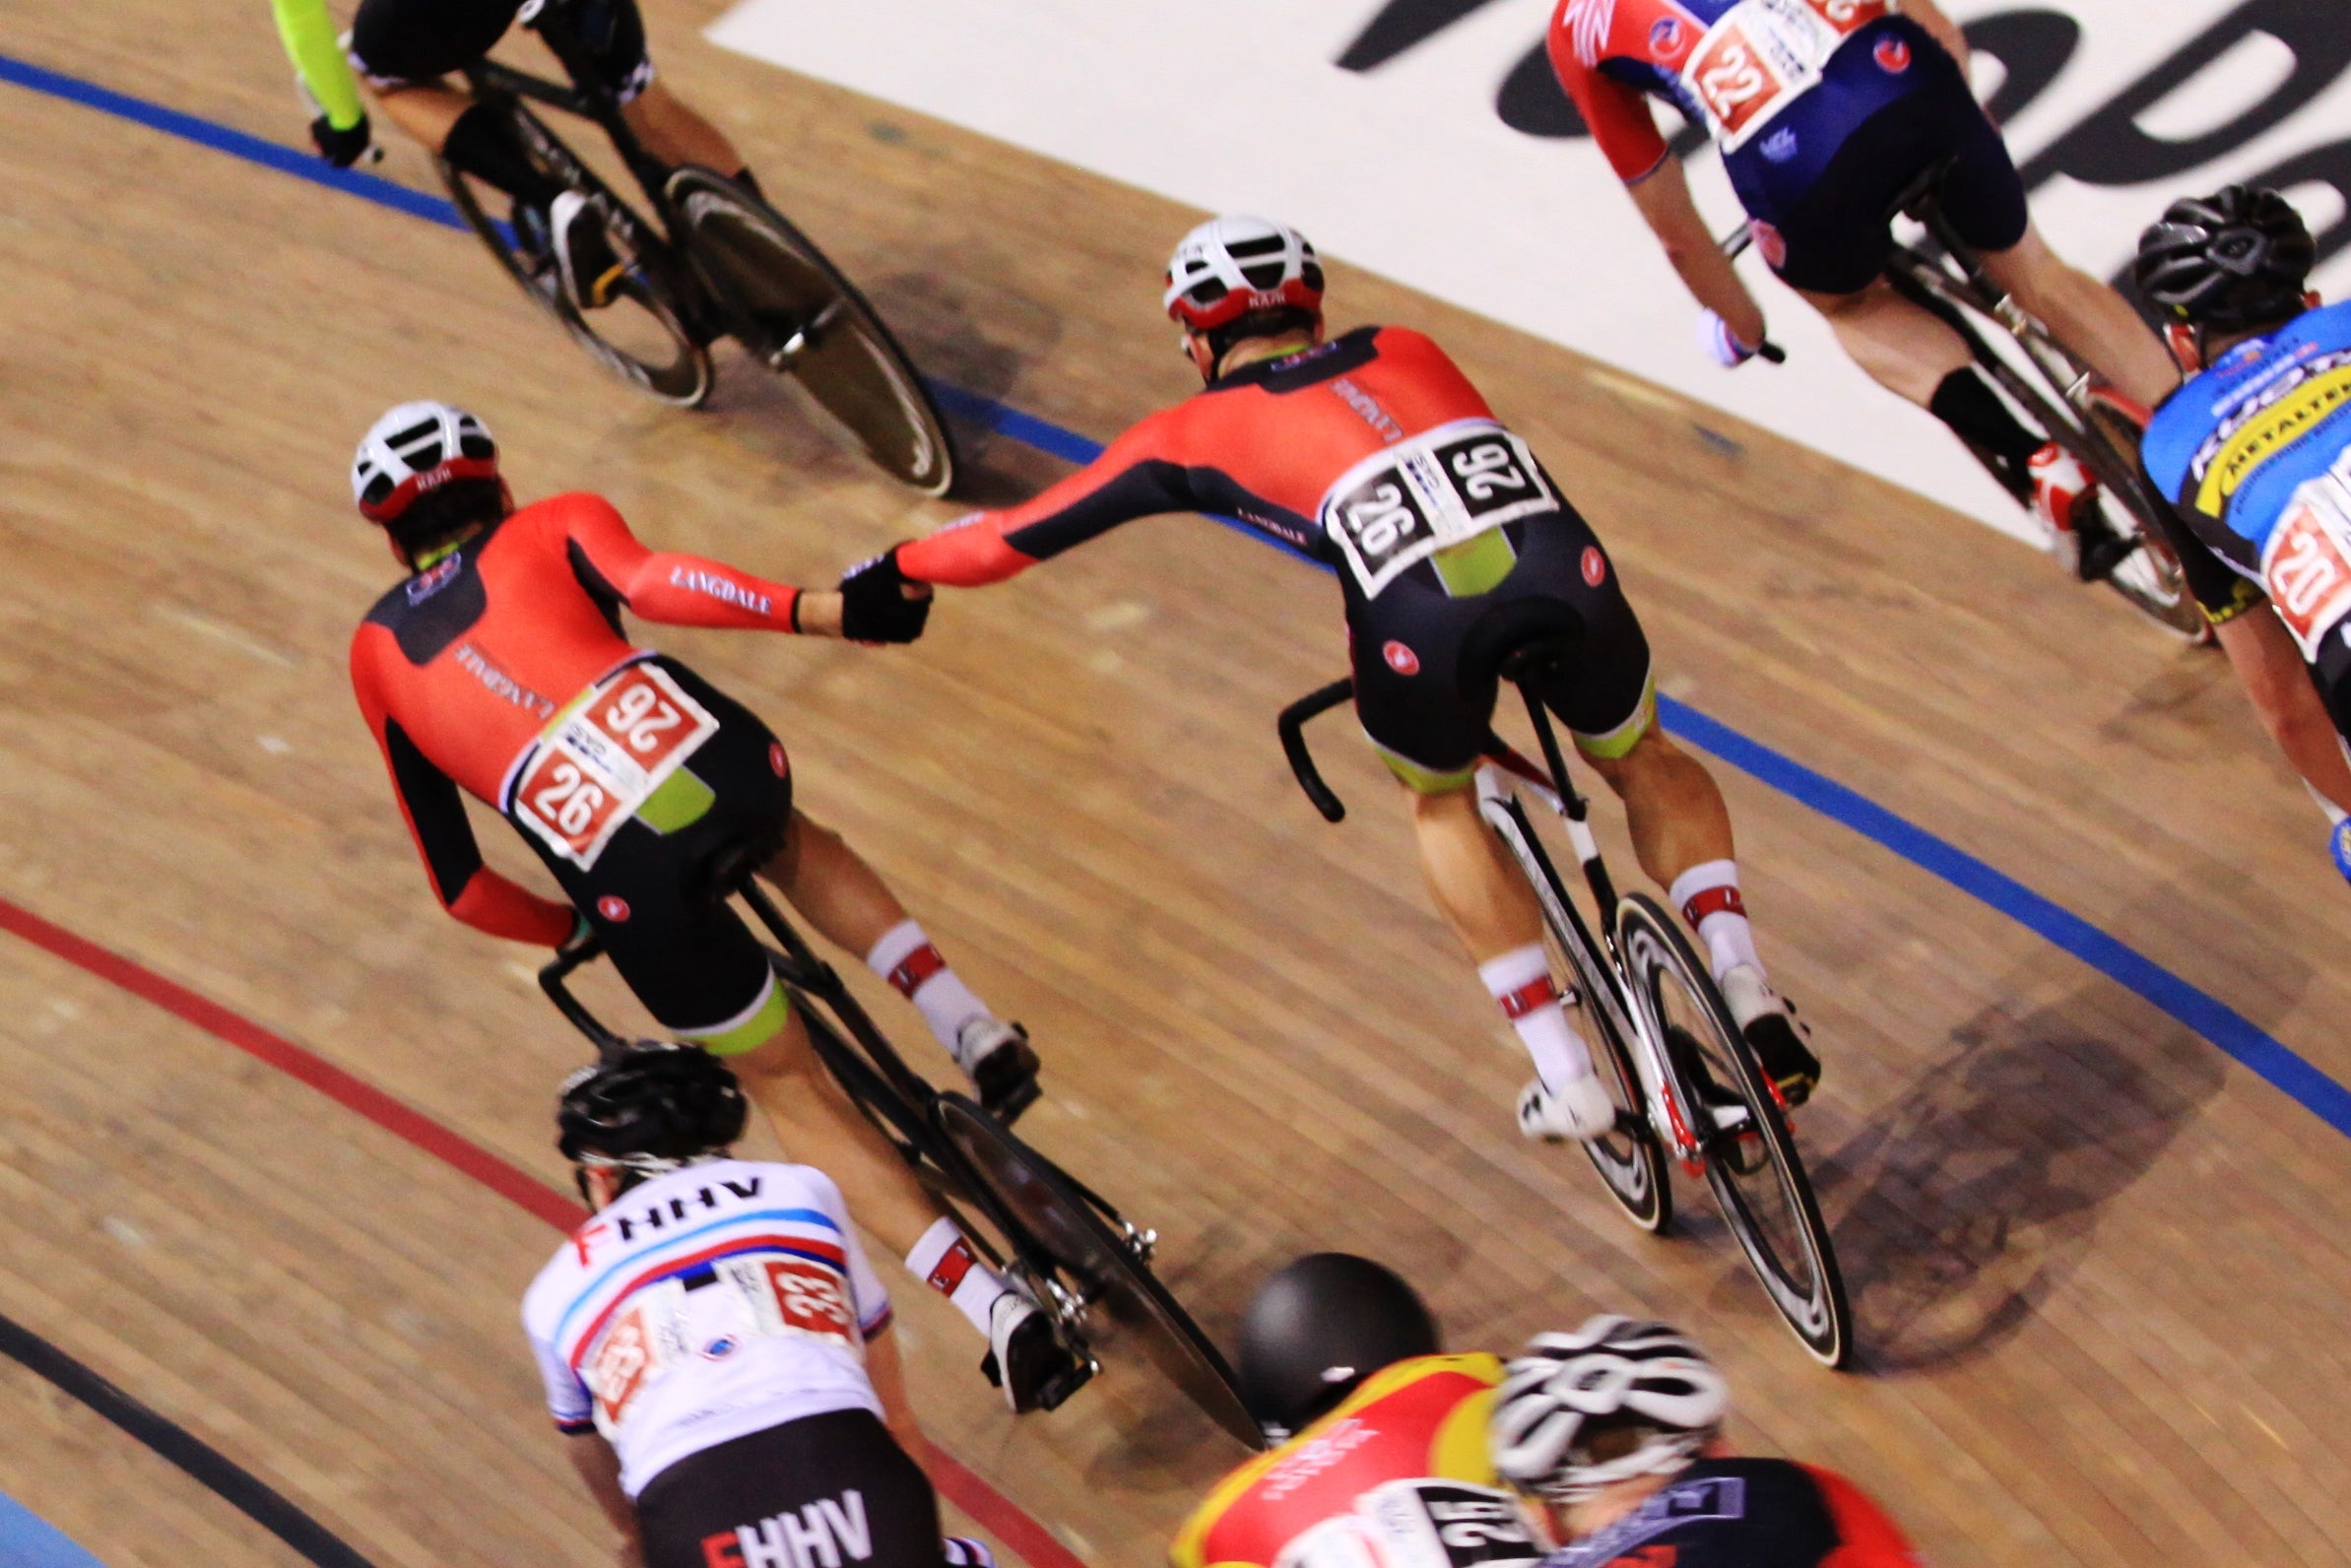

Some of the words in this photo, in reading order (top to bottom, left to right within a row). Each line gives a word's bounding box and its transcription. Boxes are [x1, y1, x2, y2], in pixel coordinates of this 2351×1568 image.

[1701, 44, 1763, 118] 22
[1452, 443, 1527, 500] 26
[1345, 482, 1416, 557] 26
[2269, 530, 2336, 618] 20
[606, 683, 683, 753] 26
[534, 761, 605, 836] 26
[570, 1176, 761, 1269] FHHV
[699, 1487, 874, 1568] FHHV
